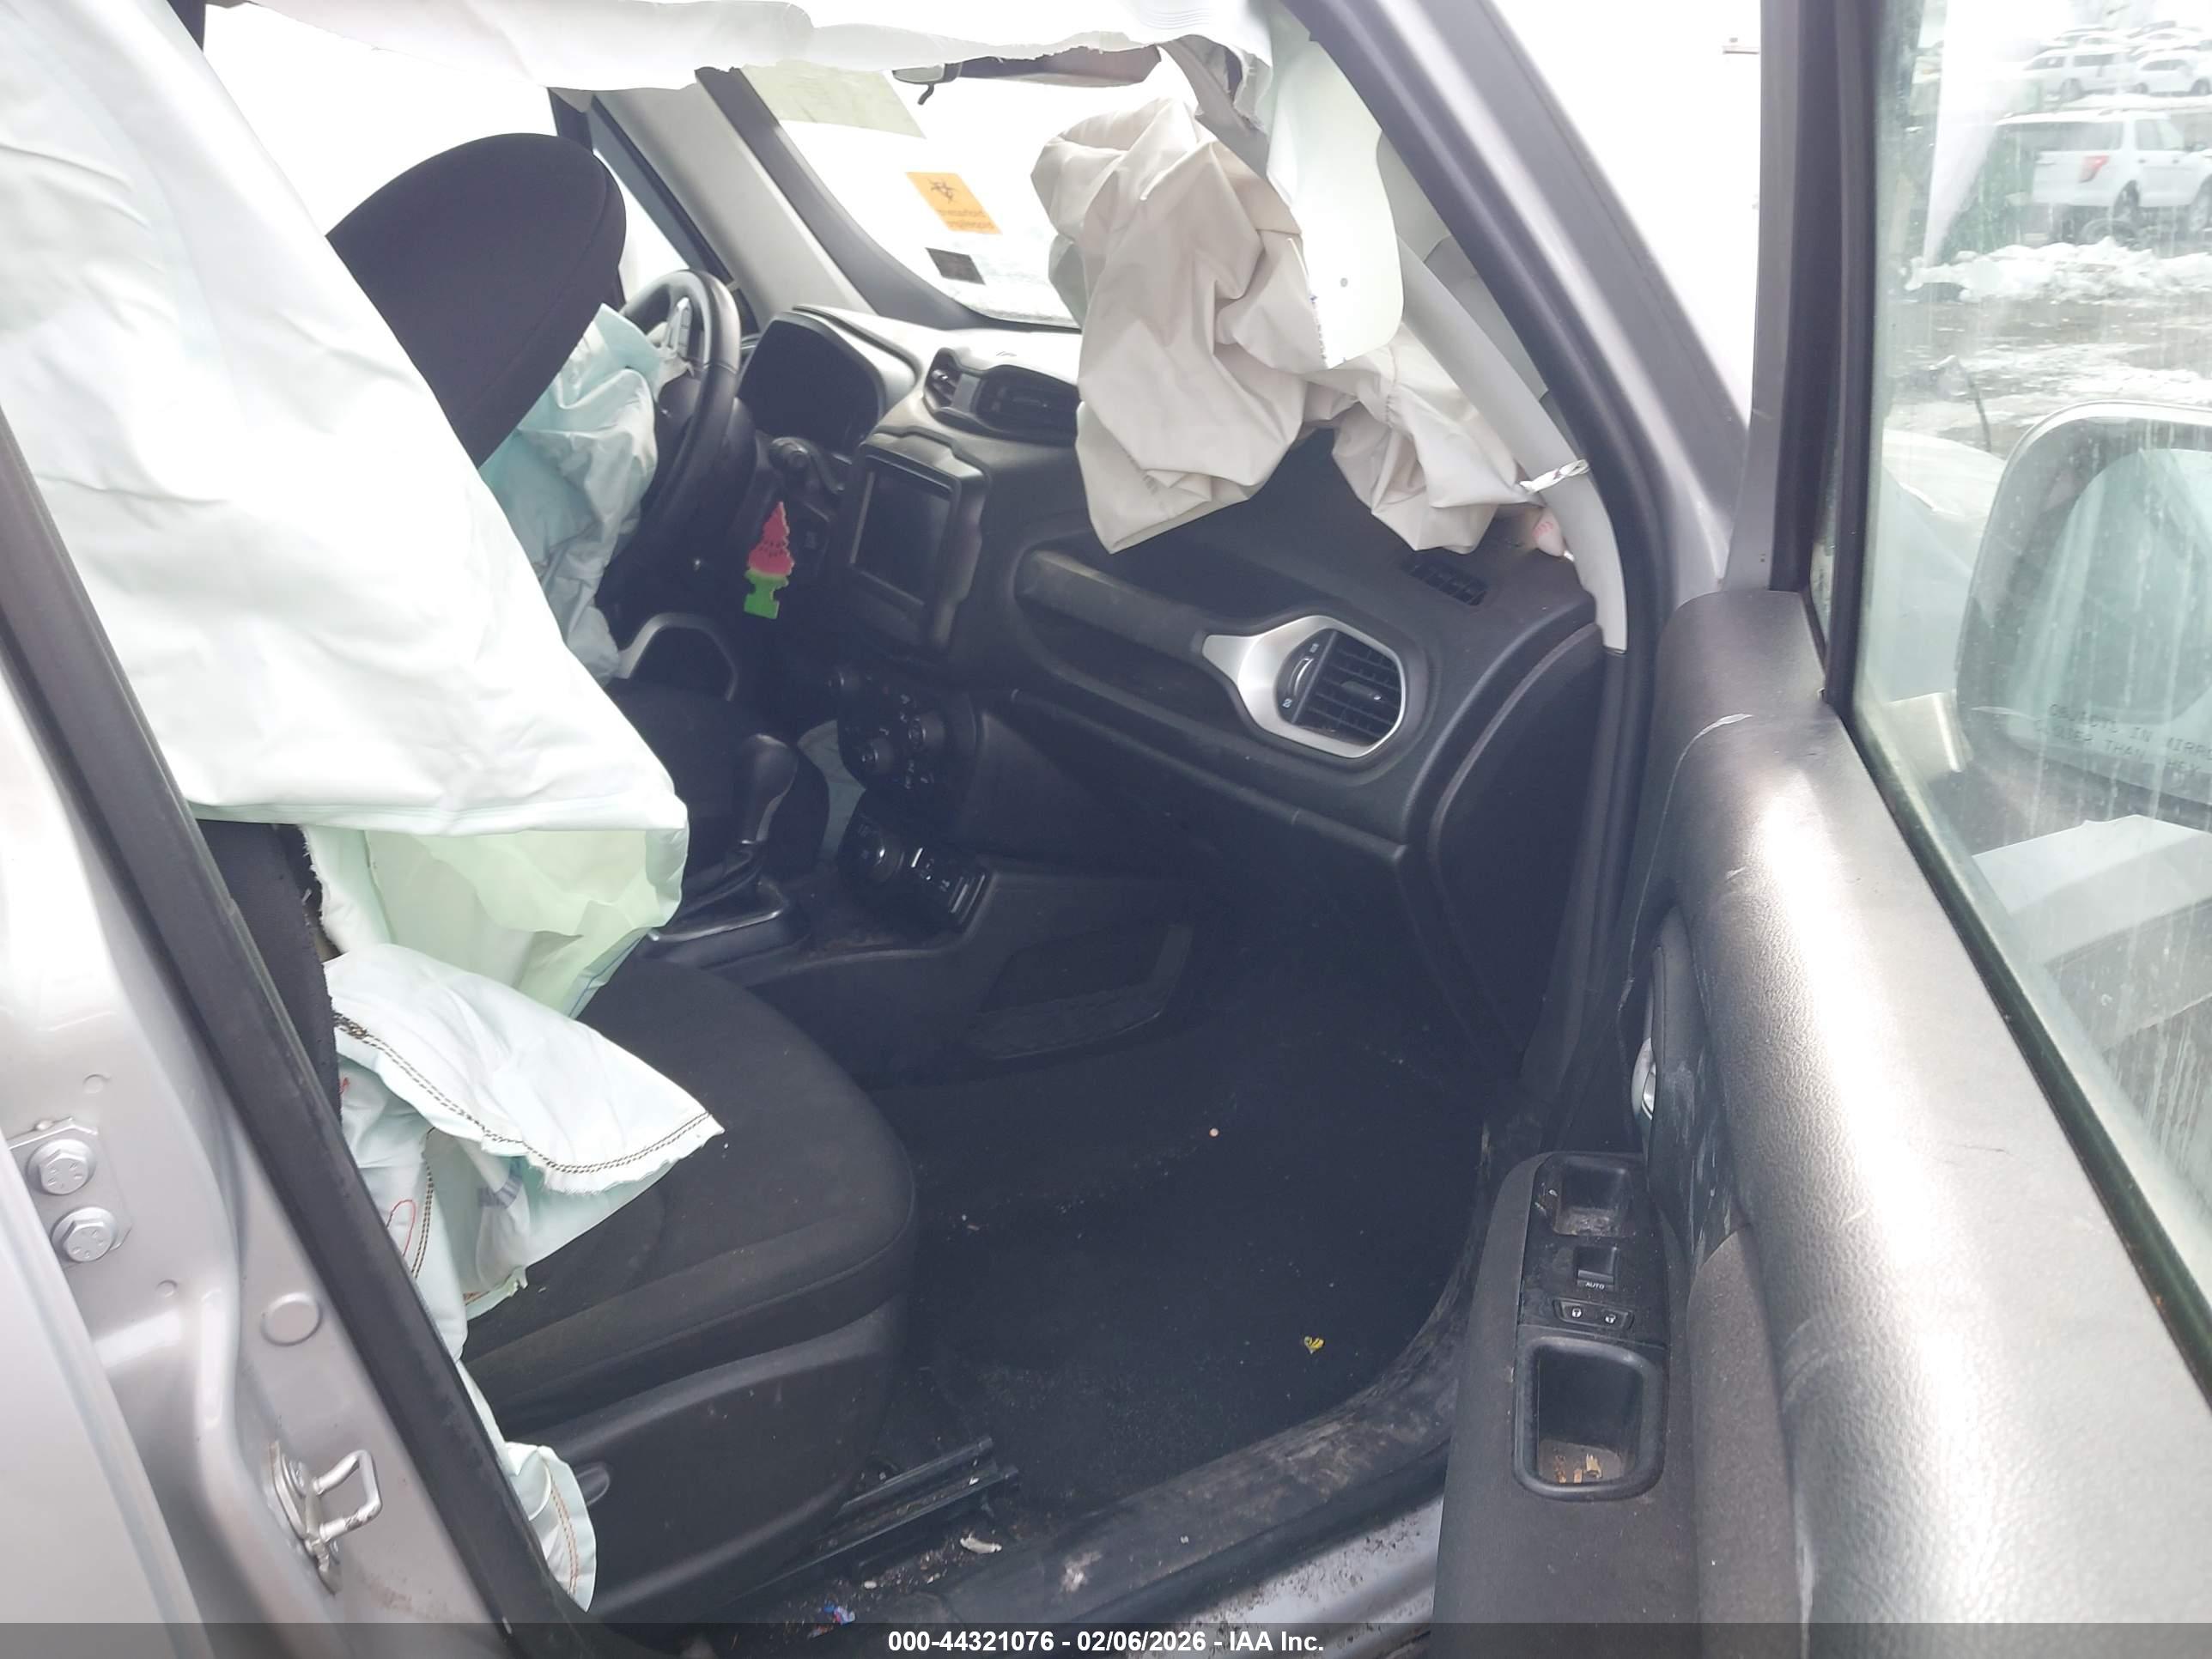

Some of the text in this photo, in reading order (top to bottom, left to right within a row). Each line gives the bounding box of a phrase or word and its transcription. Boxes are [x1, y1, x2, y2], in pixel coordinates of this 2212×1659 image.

[2034, 719, 2094, 745] COSER
[2105, 739, 2148, 760] THAN
[2129, 726, 2154, 743] IN
[1585, 1281, 1605, 1290] AUTO
